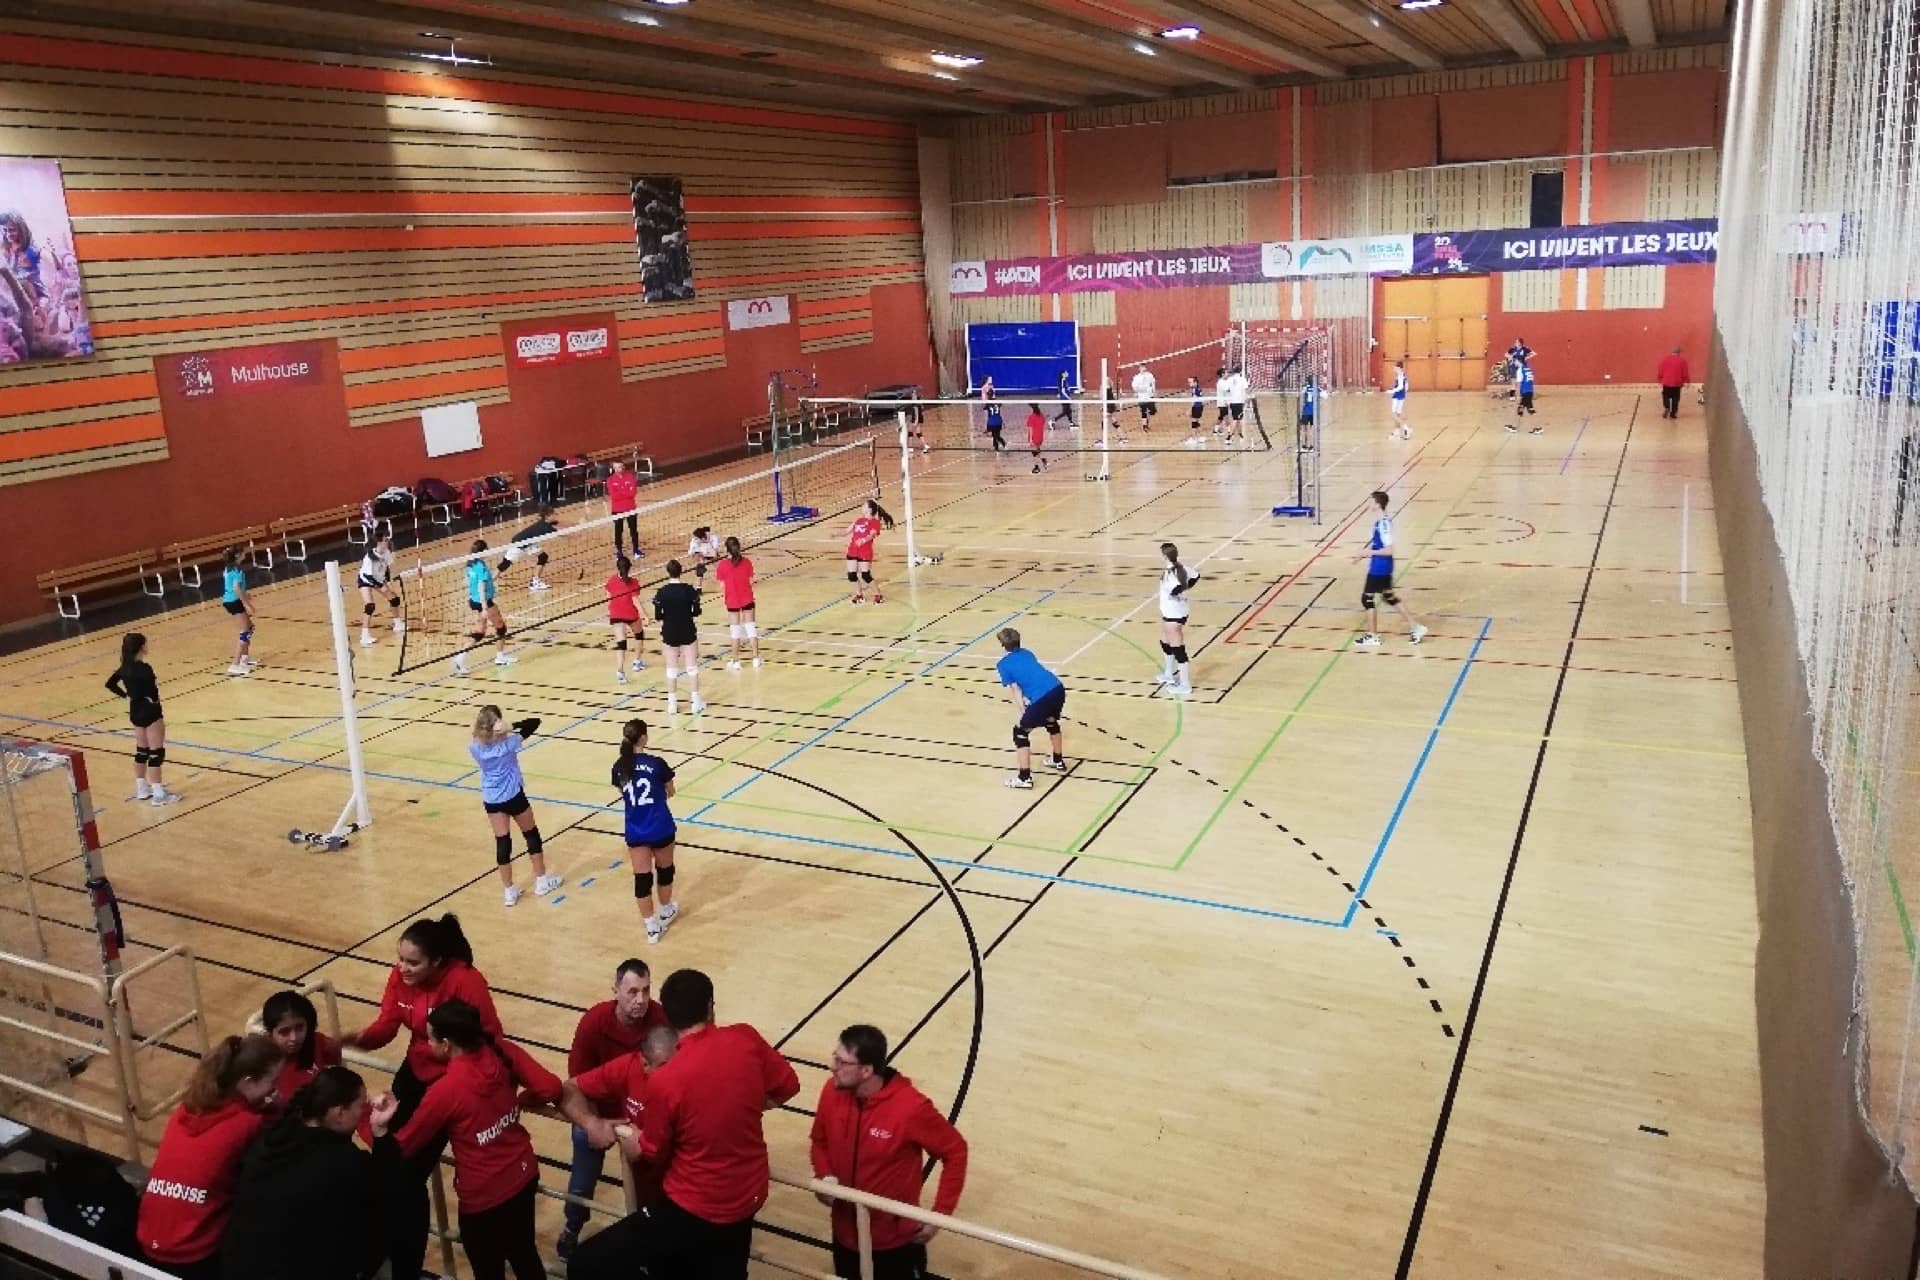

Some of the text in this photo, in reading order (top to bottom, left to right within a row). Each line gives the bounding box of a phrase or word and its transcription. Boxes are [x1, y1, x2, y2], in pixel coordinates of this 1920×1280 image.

[1503, 231, 1719, 259] ICI VIVENT LES JEUX
[1067, 255, 1231, 280] ICI VIVENT LES JEUX
[231, 362, 309, 383] Mulhouse
[622, 777, 654, 807] 12
[146, 1177, 208, 1204] MULHOUSE
